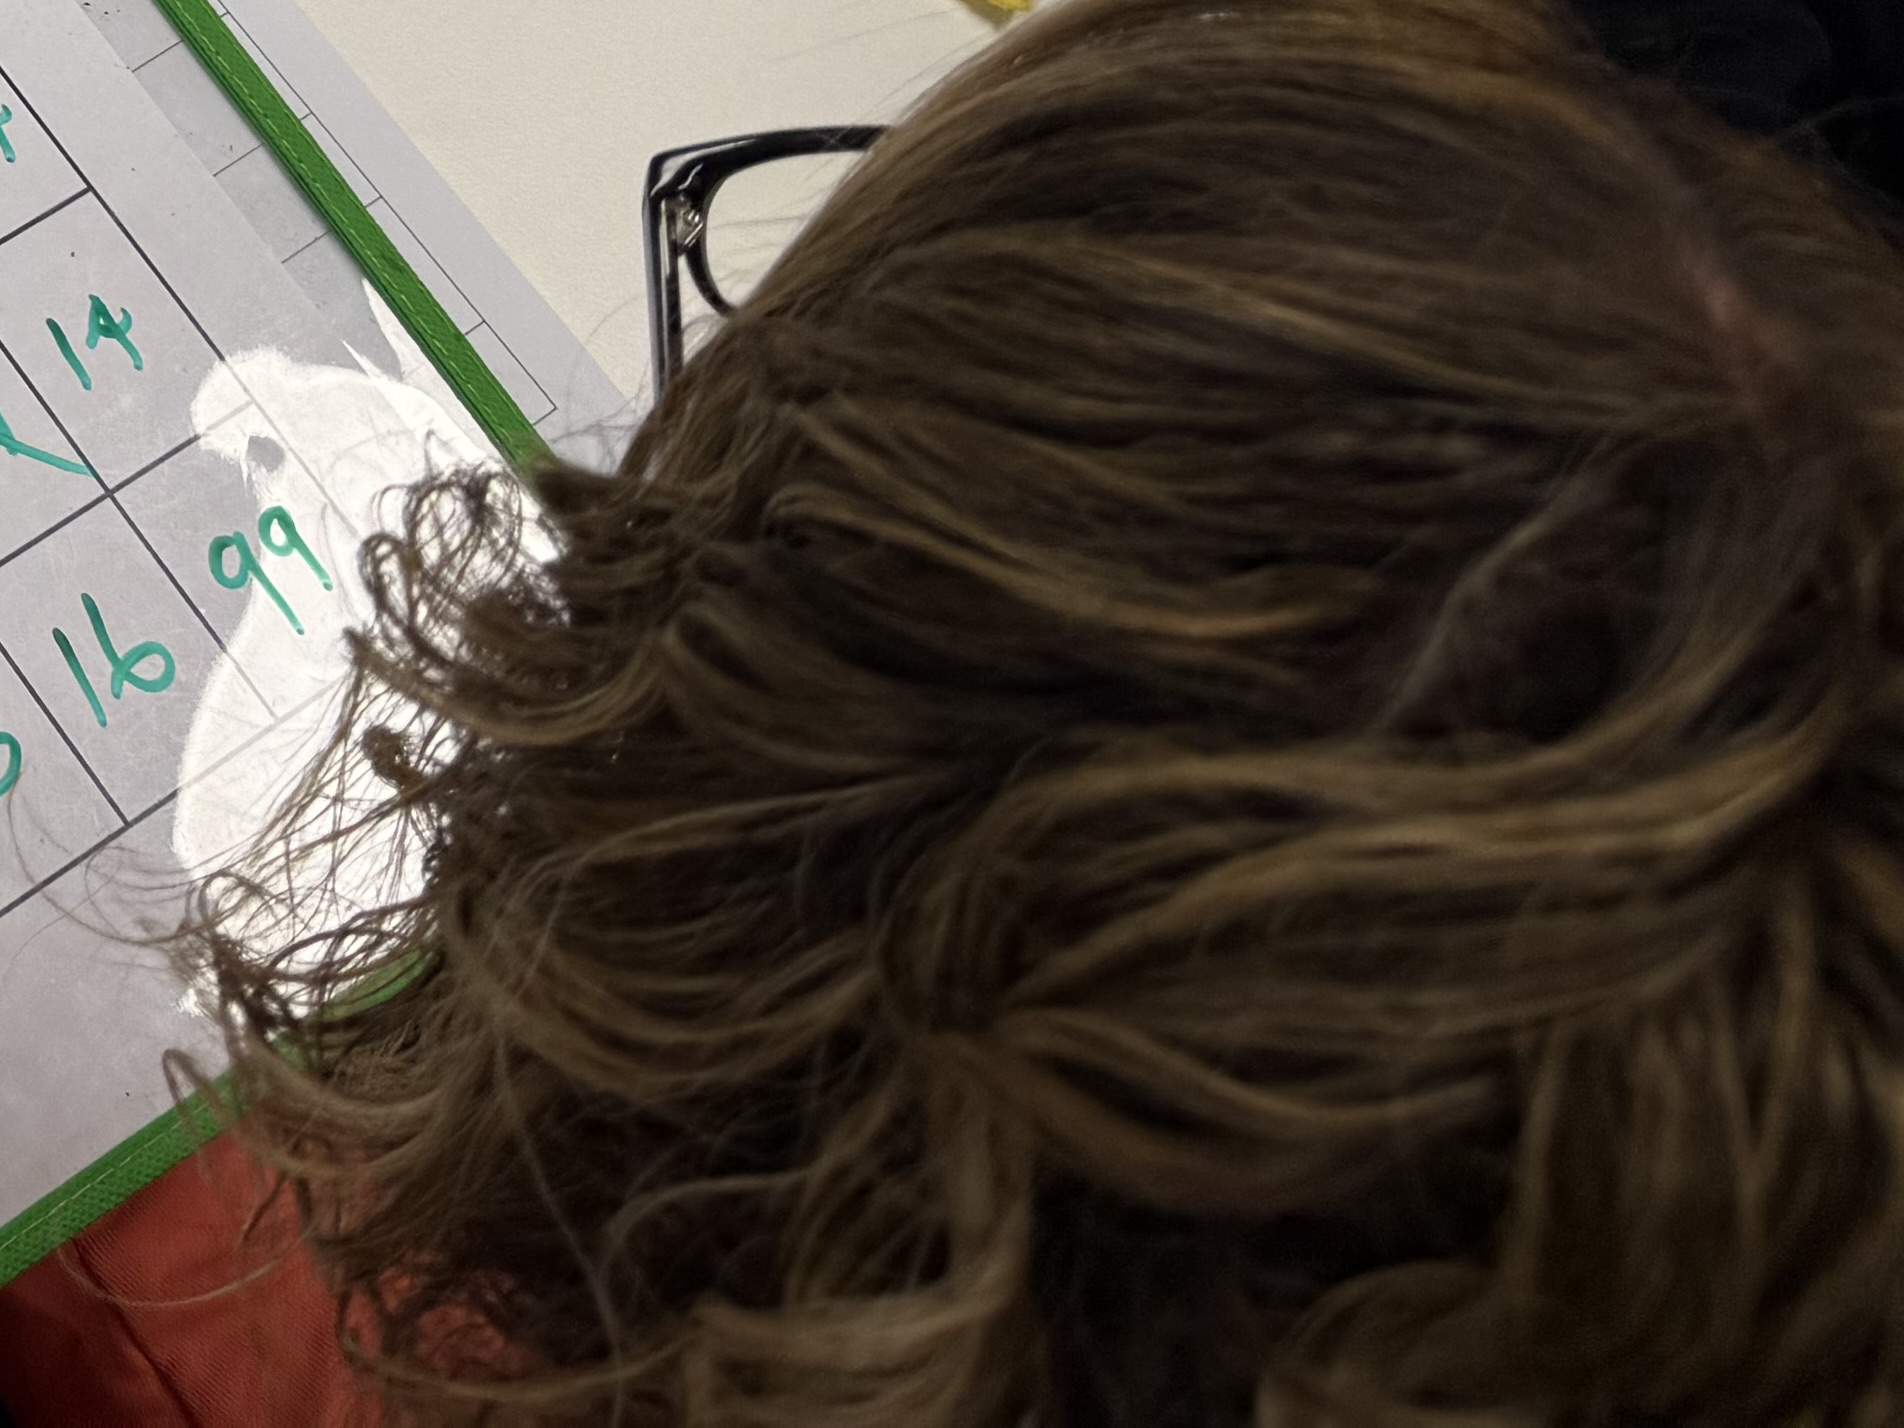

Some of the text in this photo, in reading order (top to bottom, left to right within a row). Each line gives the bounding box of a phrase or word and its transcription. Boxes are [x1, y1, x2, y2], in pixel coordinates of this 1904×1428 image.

[44, 292, 144, 391] 14
[51, 590, 177, 728] 16
[205, 502, 335, 636] 99
